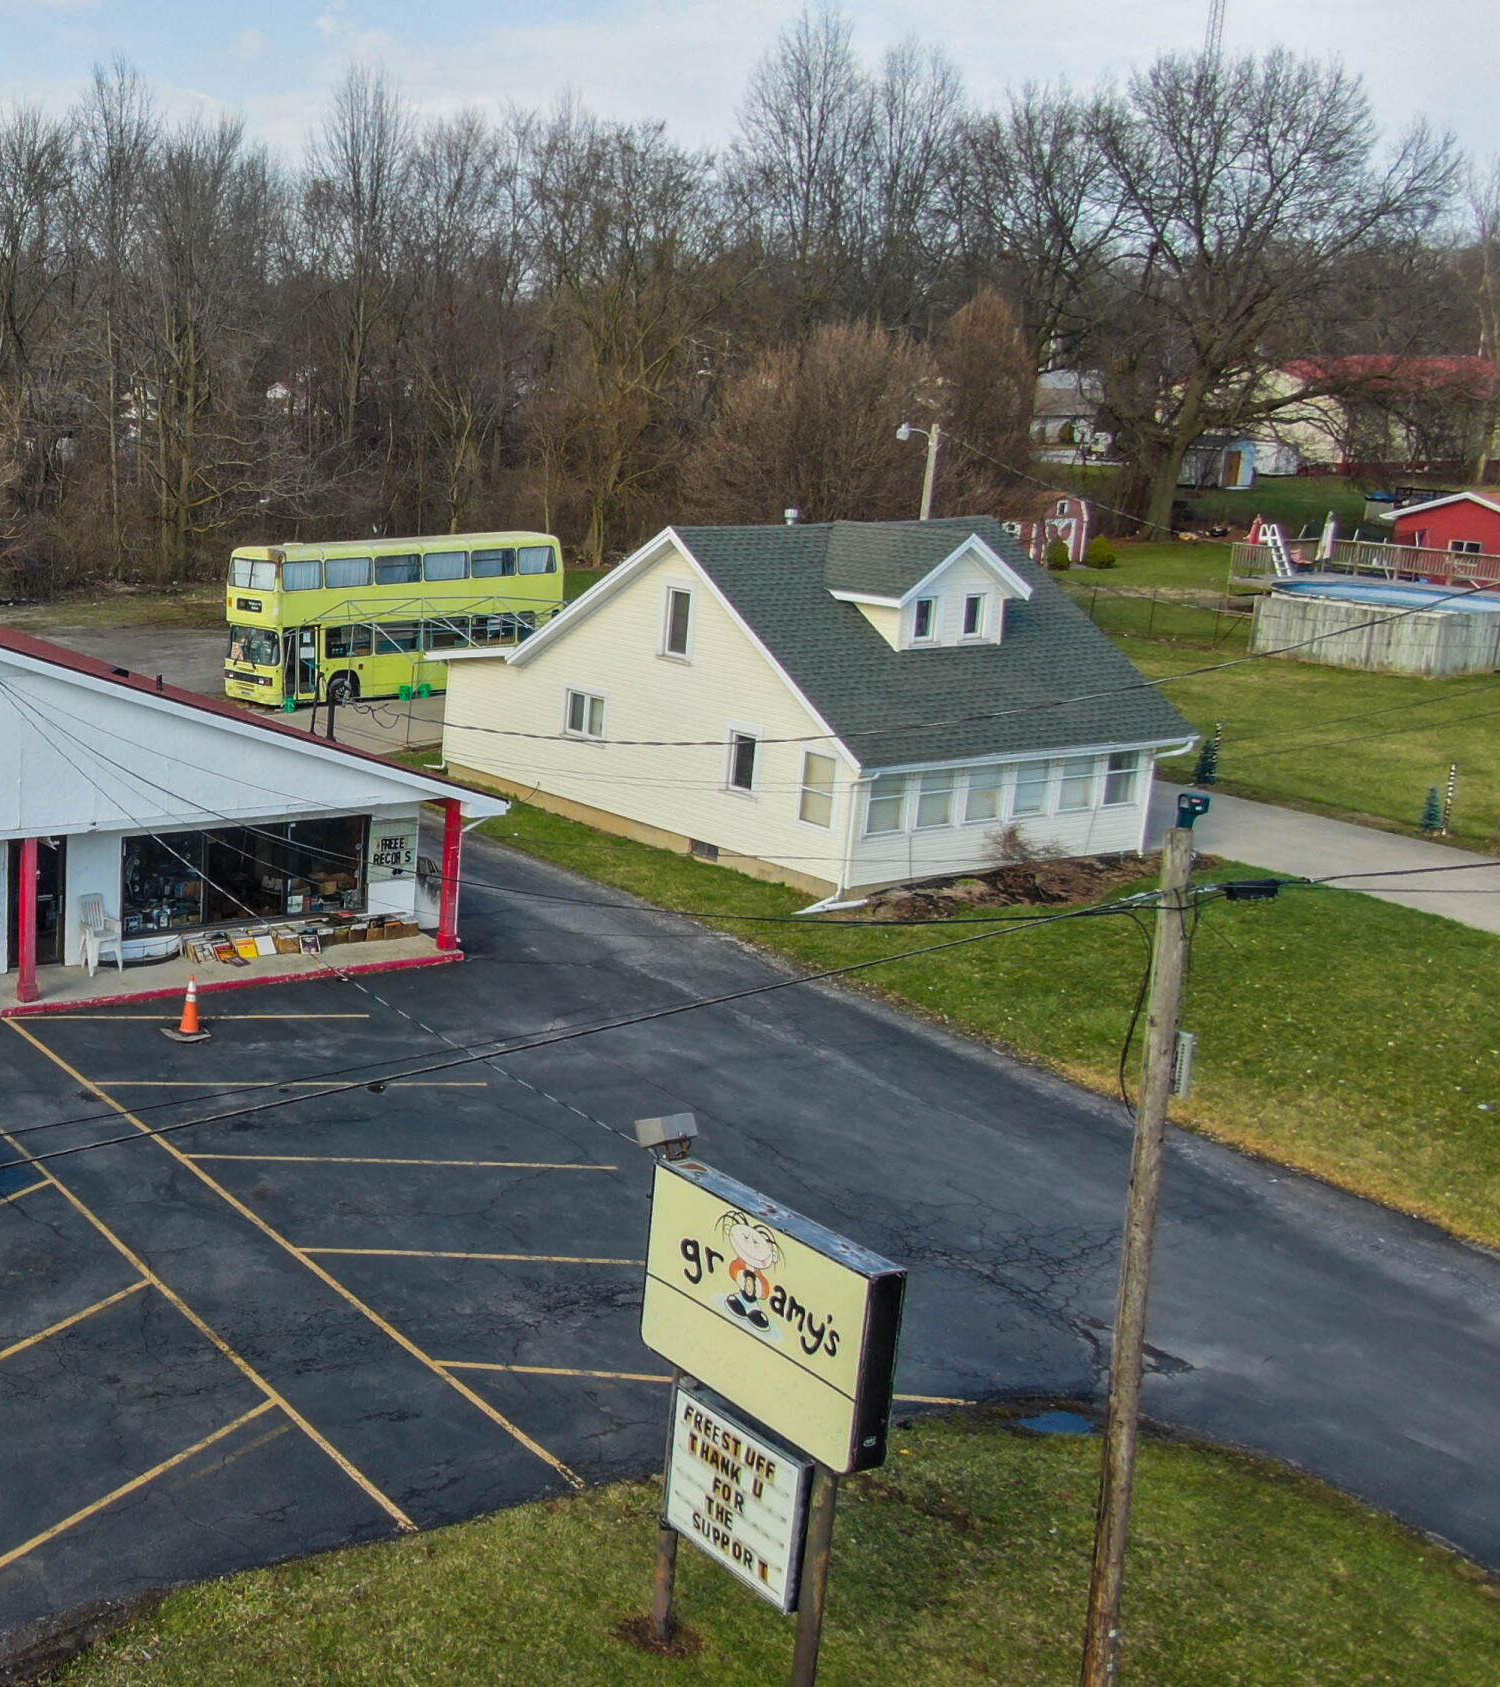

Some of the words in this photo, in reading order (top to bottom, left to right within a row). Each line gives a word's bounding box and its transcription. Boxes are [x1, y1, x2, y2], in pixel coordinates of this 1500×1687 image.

[688, 1433, 742, 1484] THANK
[752, 1477, 765, 1498] U
[705, 1496, 734, 1531] THE
[712, 1476, 745, 1513] FOR
[691, 1512, 769, 1581] SUPPORT
